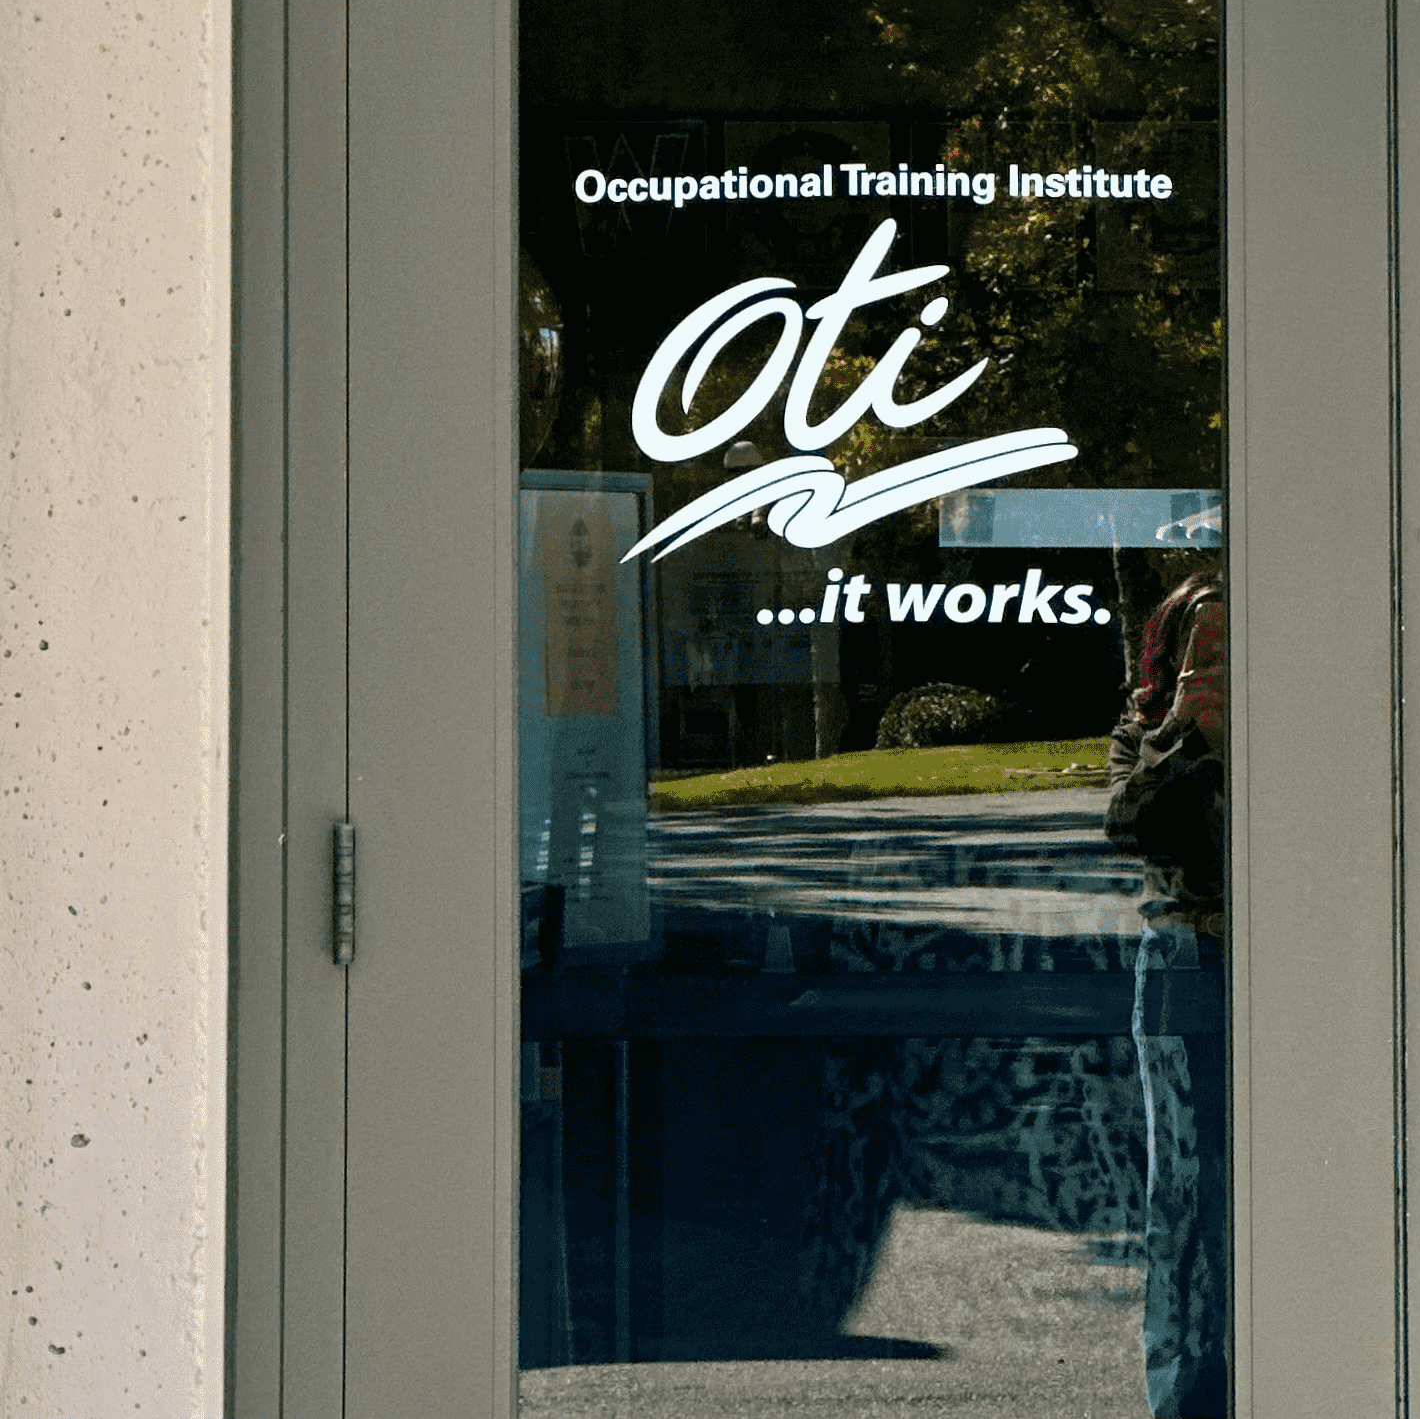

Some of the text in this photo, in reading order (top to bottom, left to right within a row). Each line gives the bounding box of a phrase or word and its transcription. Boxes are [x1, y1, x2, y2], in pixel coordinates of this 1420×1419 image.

[575, 163, 1174, 208] Occupational Training Institute
[886, 568, 1111, 625] works.
